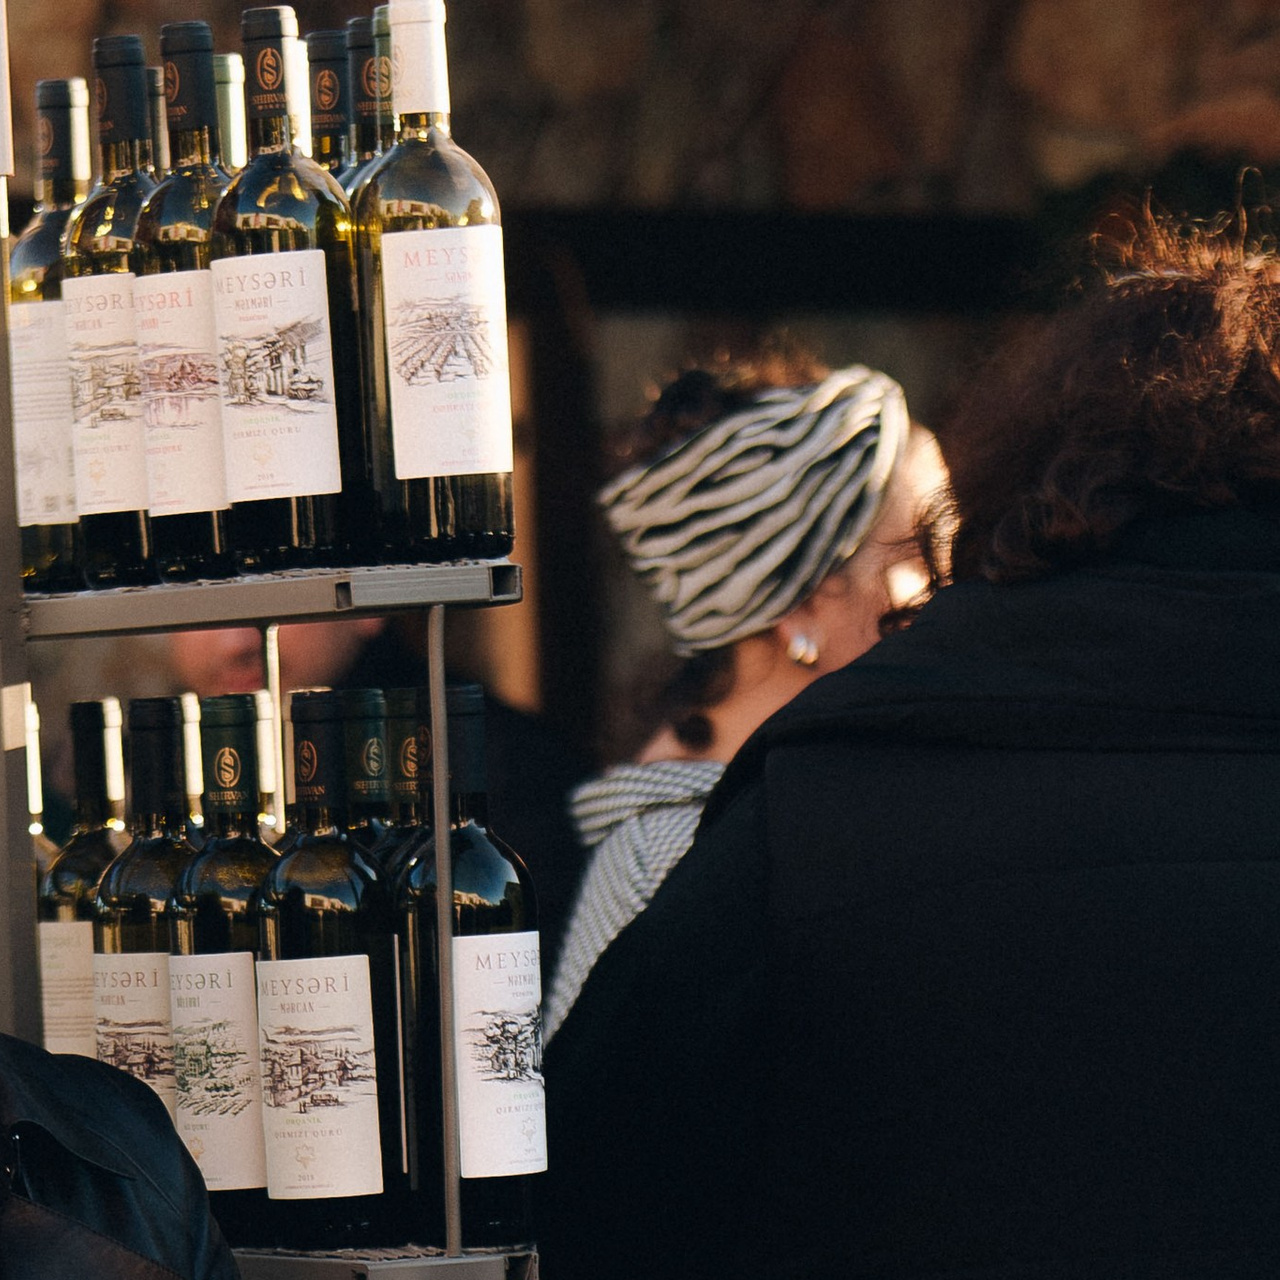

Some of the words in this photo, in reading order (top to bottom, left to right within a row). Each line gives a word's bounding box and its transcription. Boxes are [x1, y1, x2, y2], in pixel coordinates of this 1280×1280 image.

[402, 247, 469, 269] MEYS
[65, 291, 135, 315] EYSƏRİ
[475, 950, 539, 971] MEYSƏ
[172, 969, 233, 991] EYSƏRİ
[312, 1128, 344, 1139] QURU
